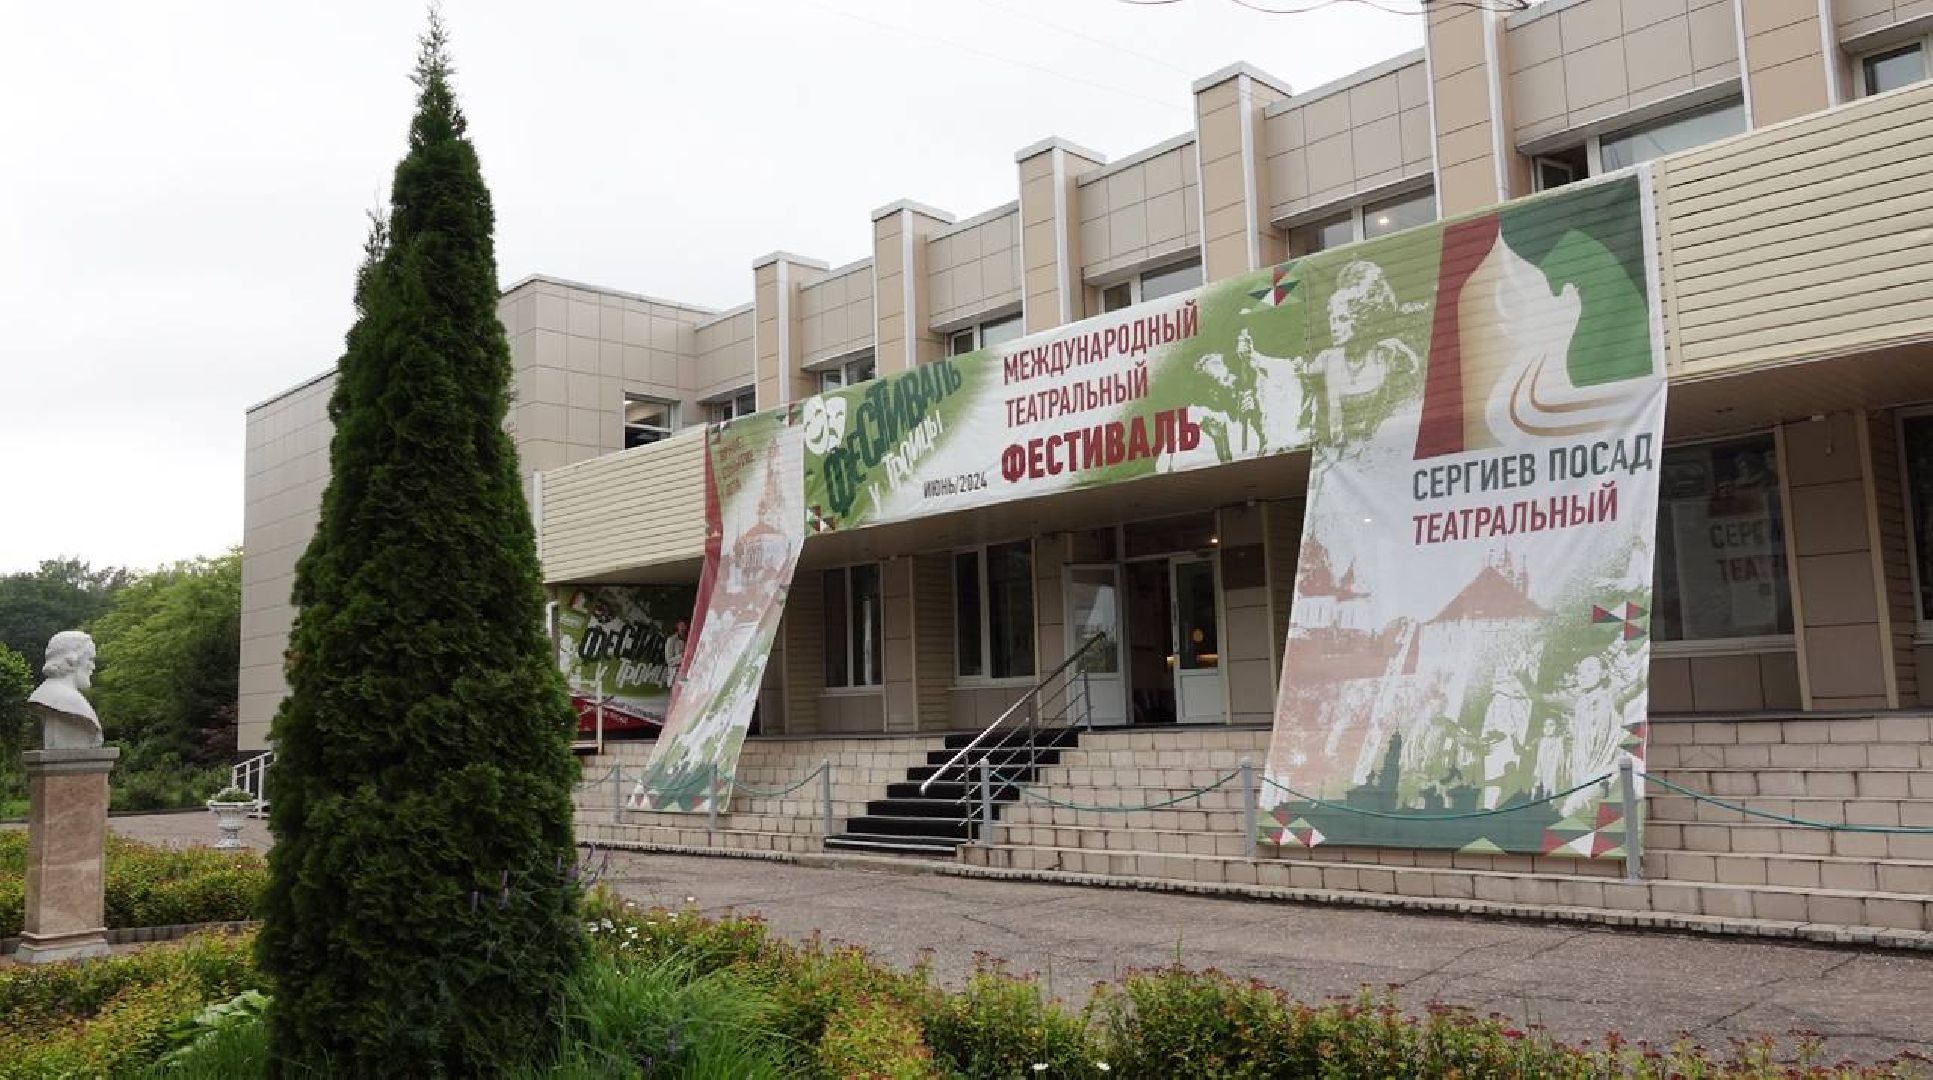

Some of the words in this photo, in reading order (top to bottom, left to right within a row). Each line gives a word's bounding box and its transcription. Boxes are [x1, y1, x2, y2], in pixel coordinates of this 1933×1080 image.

[1003, 299, 1198, 386] МЕЖДУНАРОДНЫЙ
[1005, 360, 1148, 428] ТЕАТРАЛЬНЫЙ
[824, 361, 962, 517] ФЕСТИВАЛЬ
[1001, 405, 1200, 483] ФЕСТИВАЛЬ
[1412, 453, 1535, 501] СЕРГИЕВ
[1549, 432, 1653, 476] ПОСАД
[1412, 480, 1617, 546] ТЕАТРАЛЬНЫЙ
[1710, 520, 1764, 549] СЕРГ
